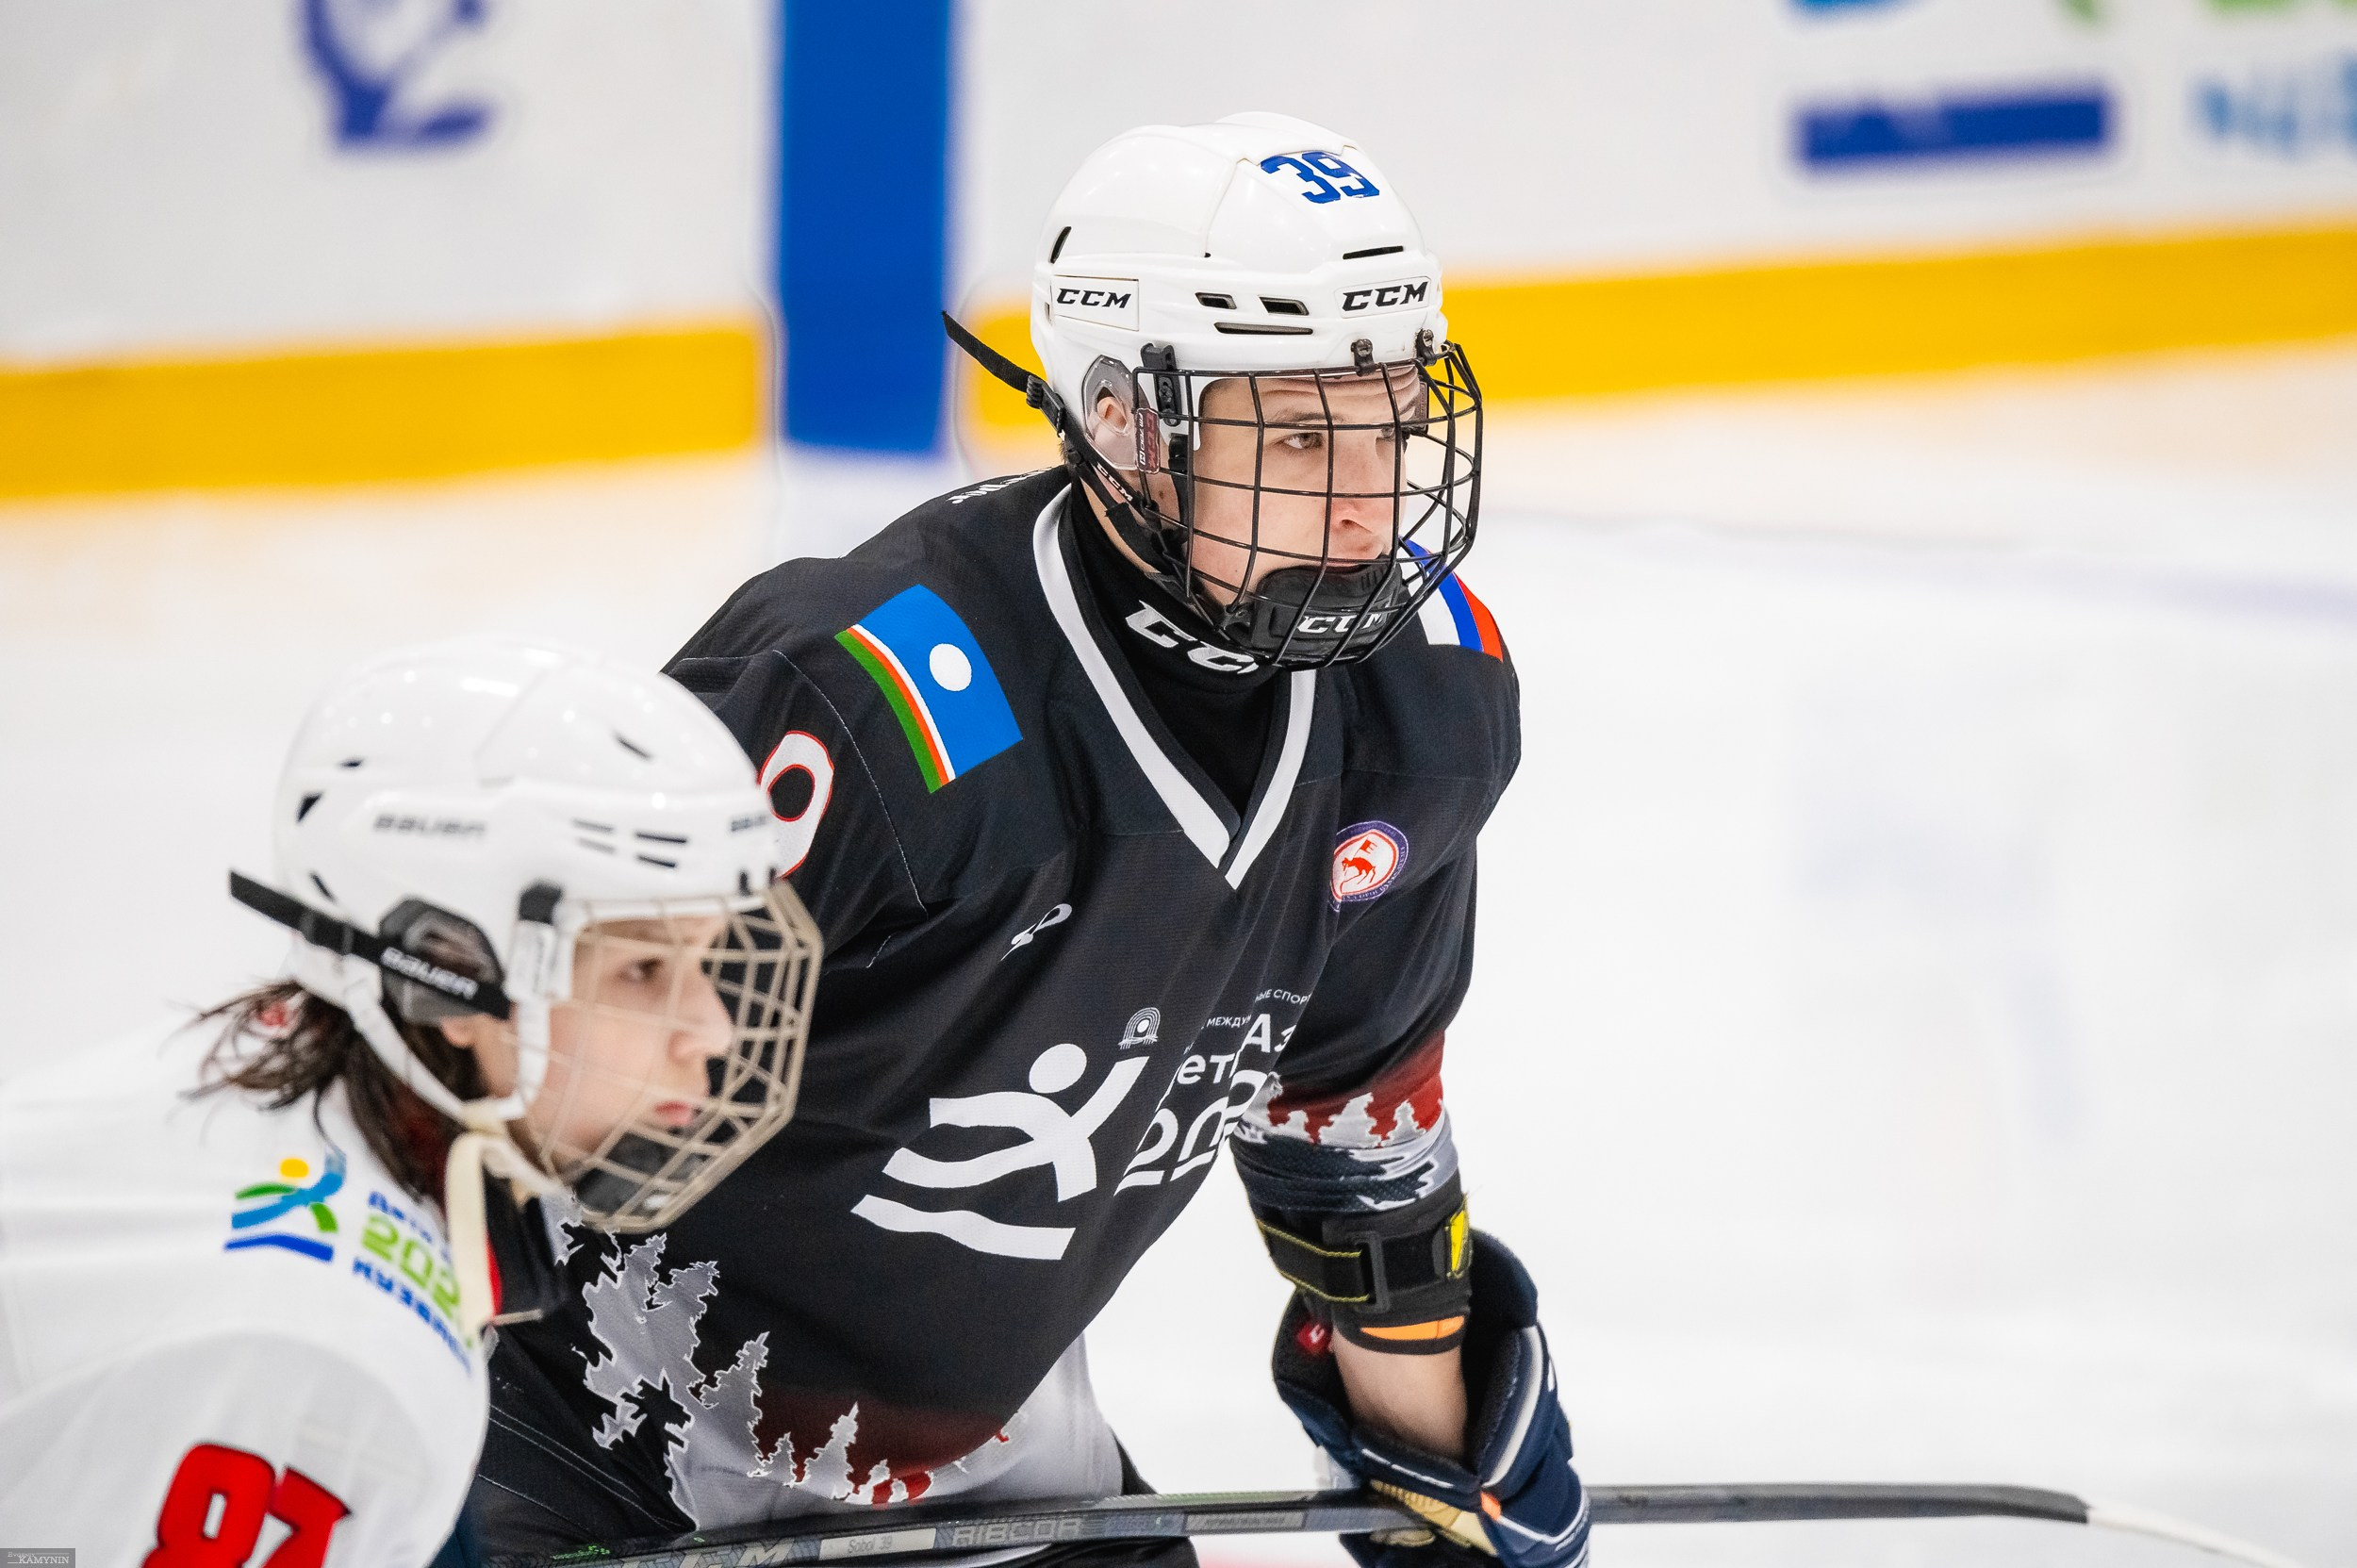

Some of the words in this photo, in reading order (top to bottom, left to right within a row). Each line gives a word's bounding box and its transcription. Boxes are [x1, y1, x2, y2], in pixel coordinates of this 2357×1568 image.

[1261, 150, 1379, 204] 39
[1056, 287, 1131, 309] CCM
[1342, 281, 1428, 312] CCM
[1096, 463, 1133, 502] CCM
[1125, 600, 1259, 674] CC
[362, 1213, 462, 1320] 202
[138, 1441, 353, 1568] 87
[952, 1518, 1082, 1546] RIBCOR
